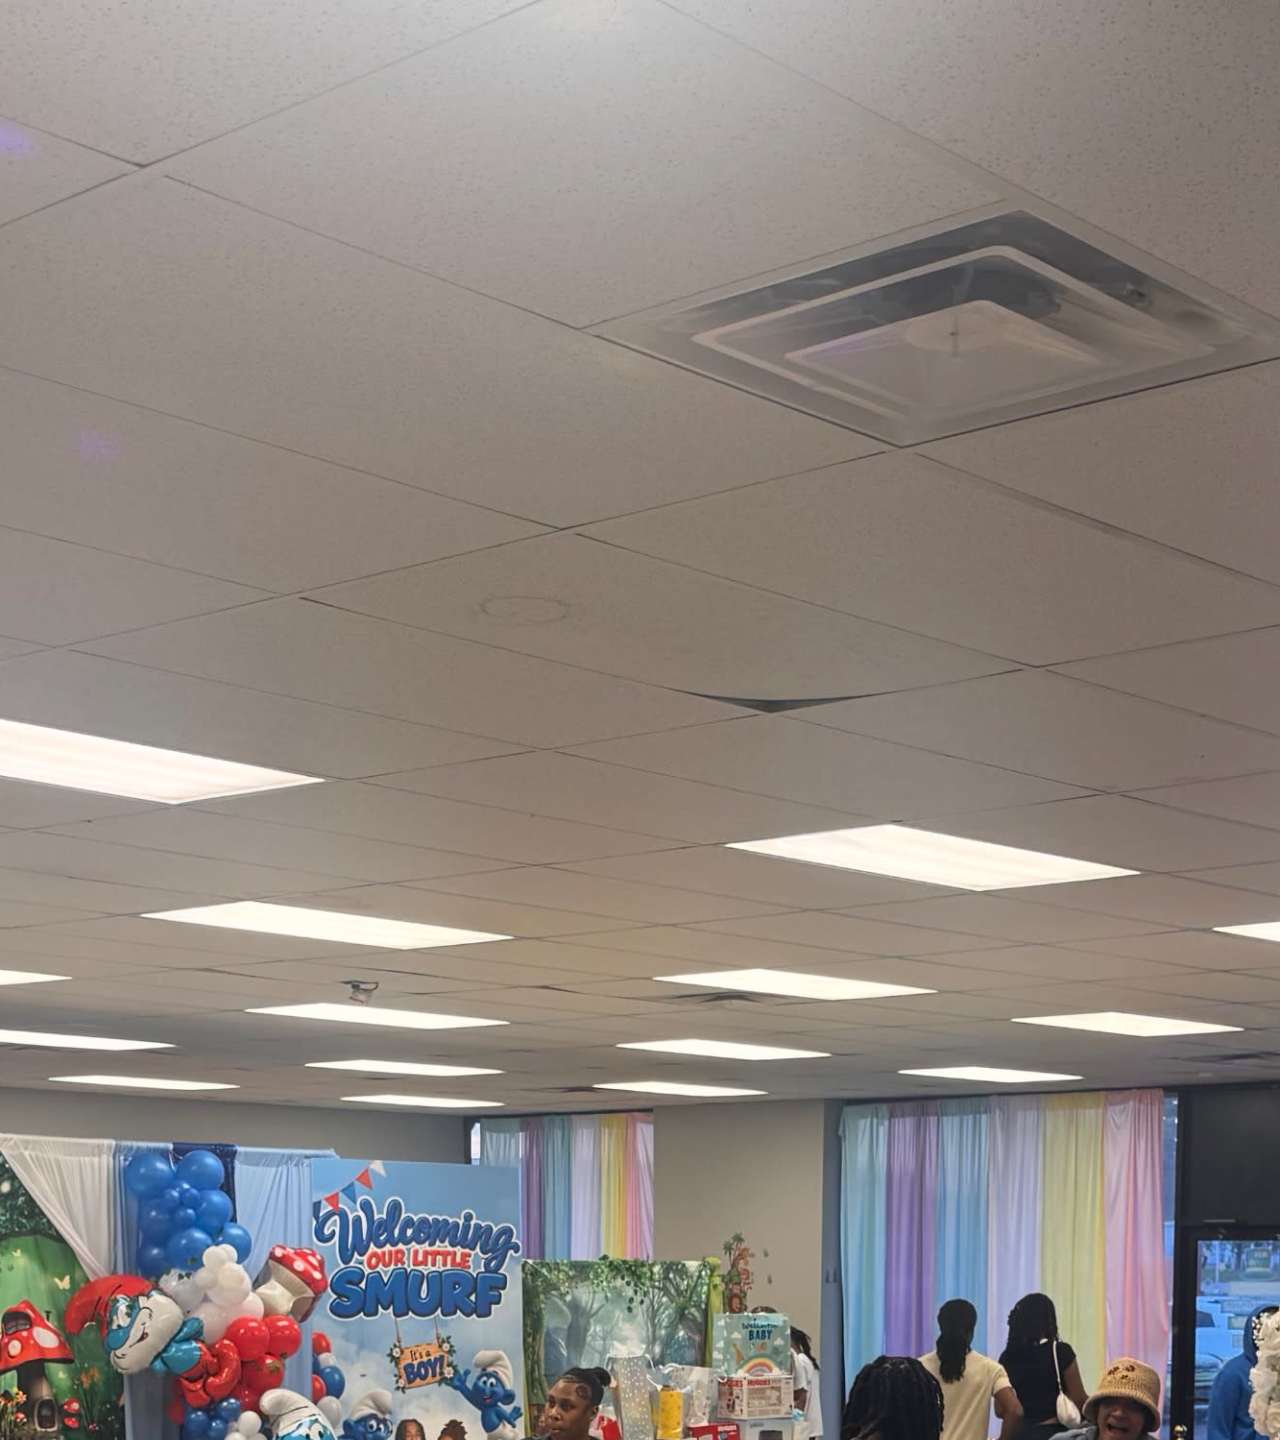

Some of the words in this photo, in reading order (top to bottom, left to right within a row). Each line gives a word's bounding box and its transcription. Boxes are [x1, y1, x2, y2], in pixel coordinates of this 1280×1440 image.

[314, 1199, 519, 1272] Welcoming
[366, 1250, 405, 1270] OUR
[412, 1250, 471, 1270] LITTLE
[329, 1266, 507, 1318] SMURF
[749, 1330, 772, 1341] BABY
[410, 1349, 424, 1361] It's
[403, 1354, 445, 1385] BOY!
